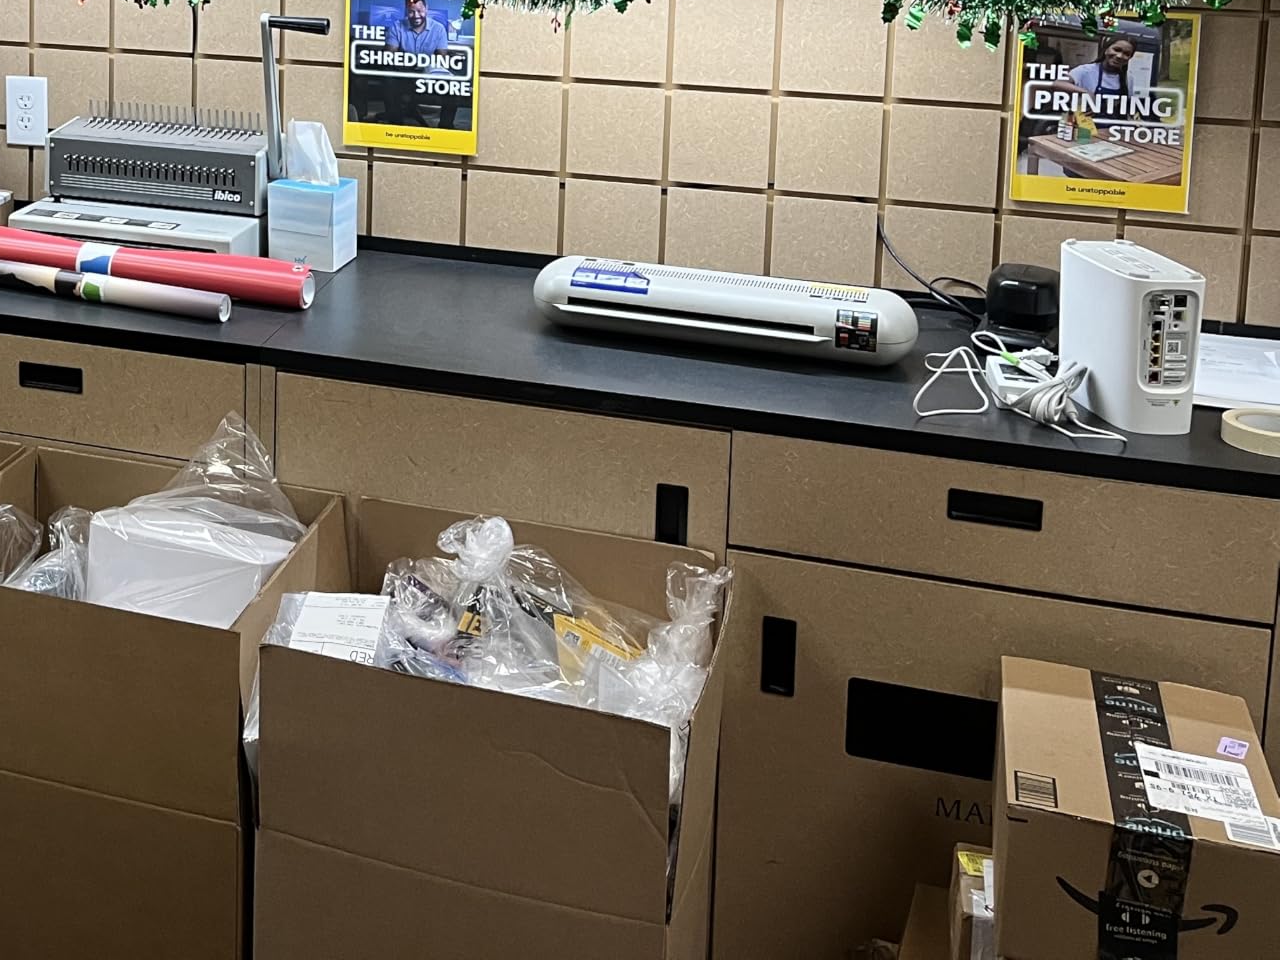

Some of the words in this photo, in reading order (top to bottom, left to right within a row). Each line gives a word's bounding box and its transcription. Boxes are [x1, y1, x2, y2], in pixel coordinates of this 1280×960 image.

[352, 24, 386, 40] THE
[359, 50, 463, 70] SHREDDING
[1026, 63, 1070, 81] THE
[415, 79, 471, 96] STORE
[1034, 90, 1172, 118] PRINTING
[1108, 125, 1181, 145] STORE
